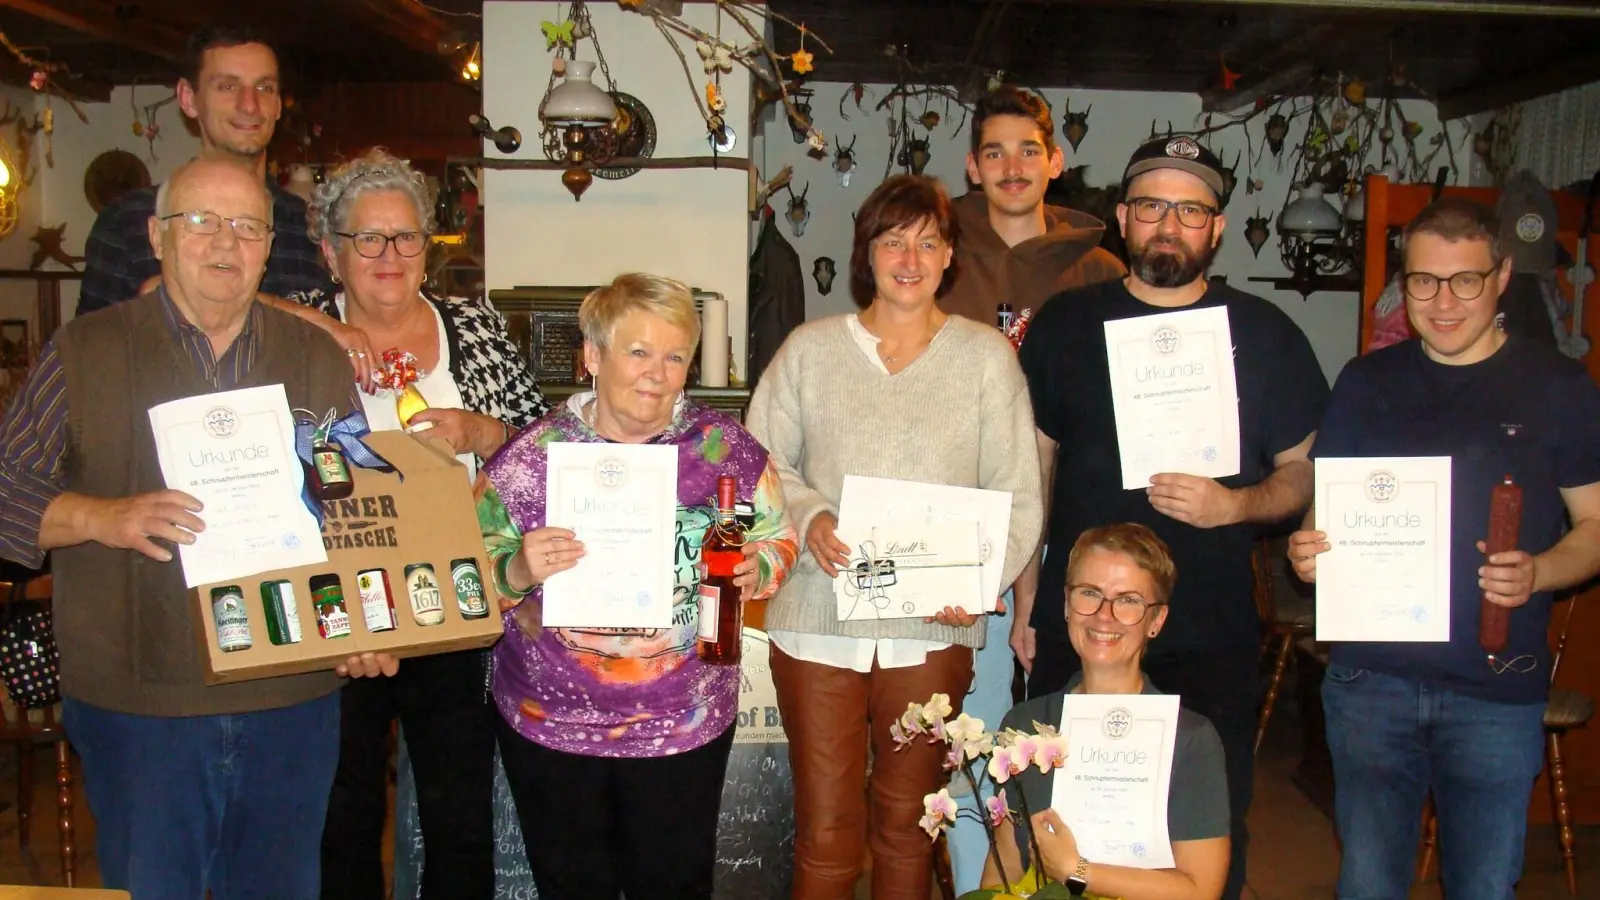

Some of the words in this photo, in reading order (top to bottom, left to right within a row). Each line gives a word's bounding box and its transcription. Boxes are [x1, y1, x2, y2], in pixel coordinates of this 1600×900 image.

[1135, 359, 1204, 383] Urkunde
[188, 442, 269, 468] Urkunde
[201, 468, 280, 486] Schnupfermeisterschaft
[322, 494, 399, 519] NNER
[1343, 508, 1421, 529] Urkunde
[322, 526, 398, 551] DTASCHE
[883, 540, 919, 555] Lindt
[1350, 539, 1426, 547] Schnupfermeisterschaft
[413, 589, 439, 610] 1617
[737, 706, 759, 728] of
[736, 731, 764, 739] eunden
[1080, 745, 1148, 765] Urkunde
